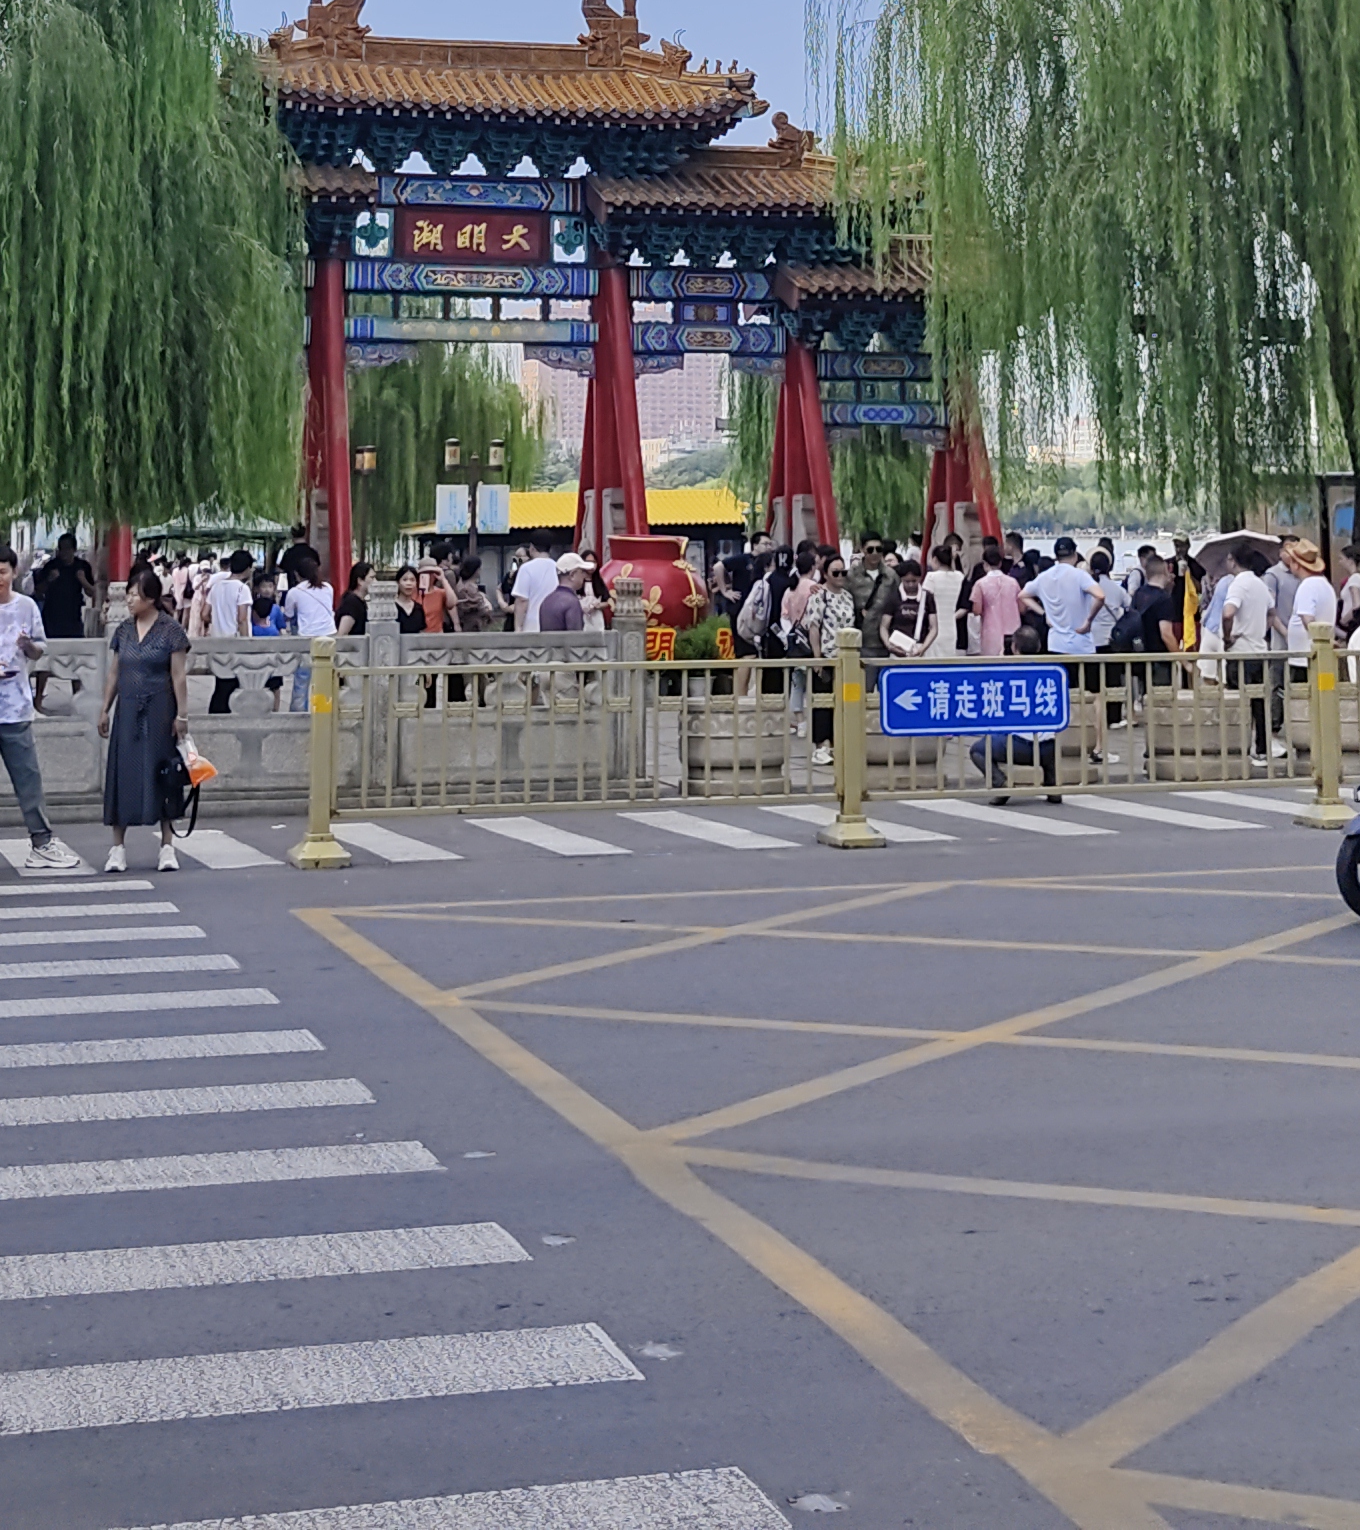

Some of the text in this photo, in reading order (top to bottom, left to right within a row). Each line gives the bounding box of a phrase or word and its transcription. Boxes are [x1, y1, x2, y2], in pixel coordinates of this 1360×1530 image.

[412, 220, 531, 253] 大明湖
[927, 677, 1058, 721] 请走斑马线
